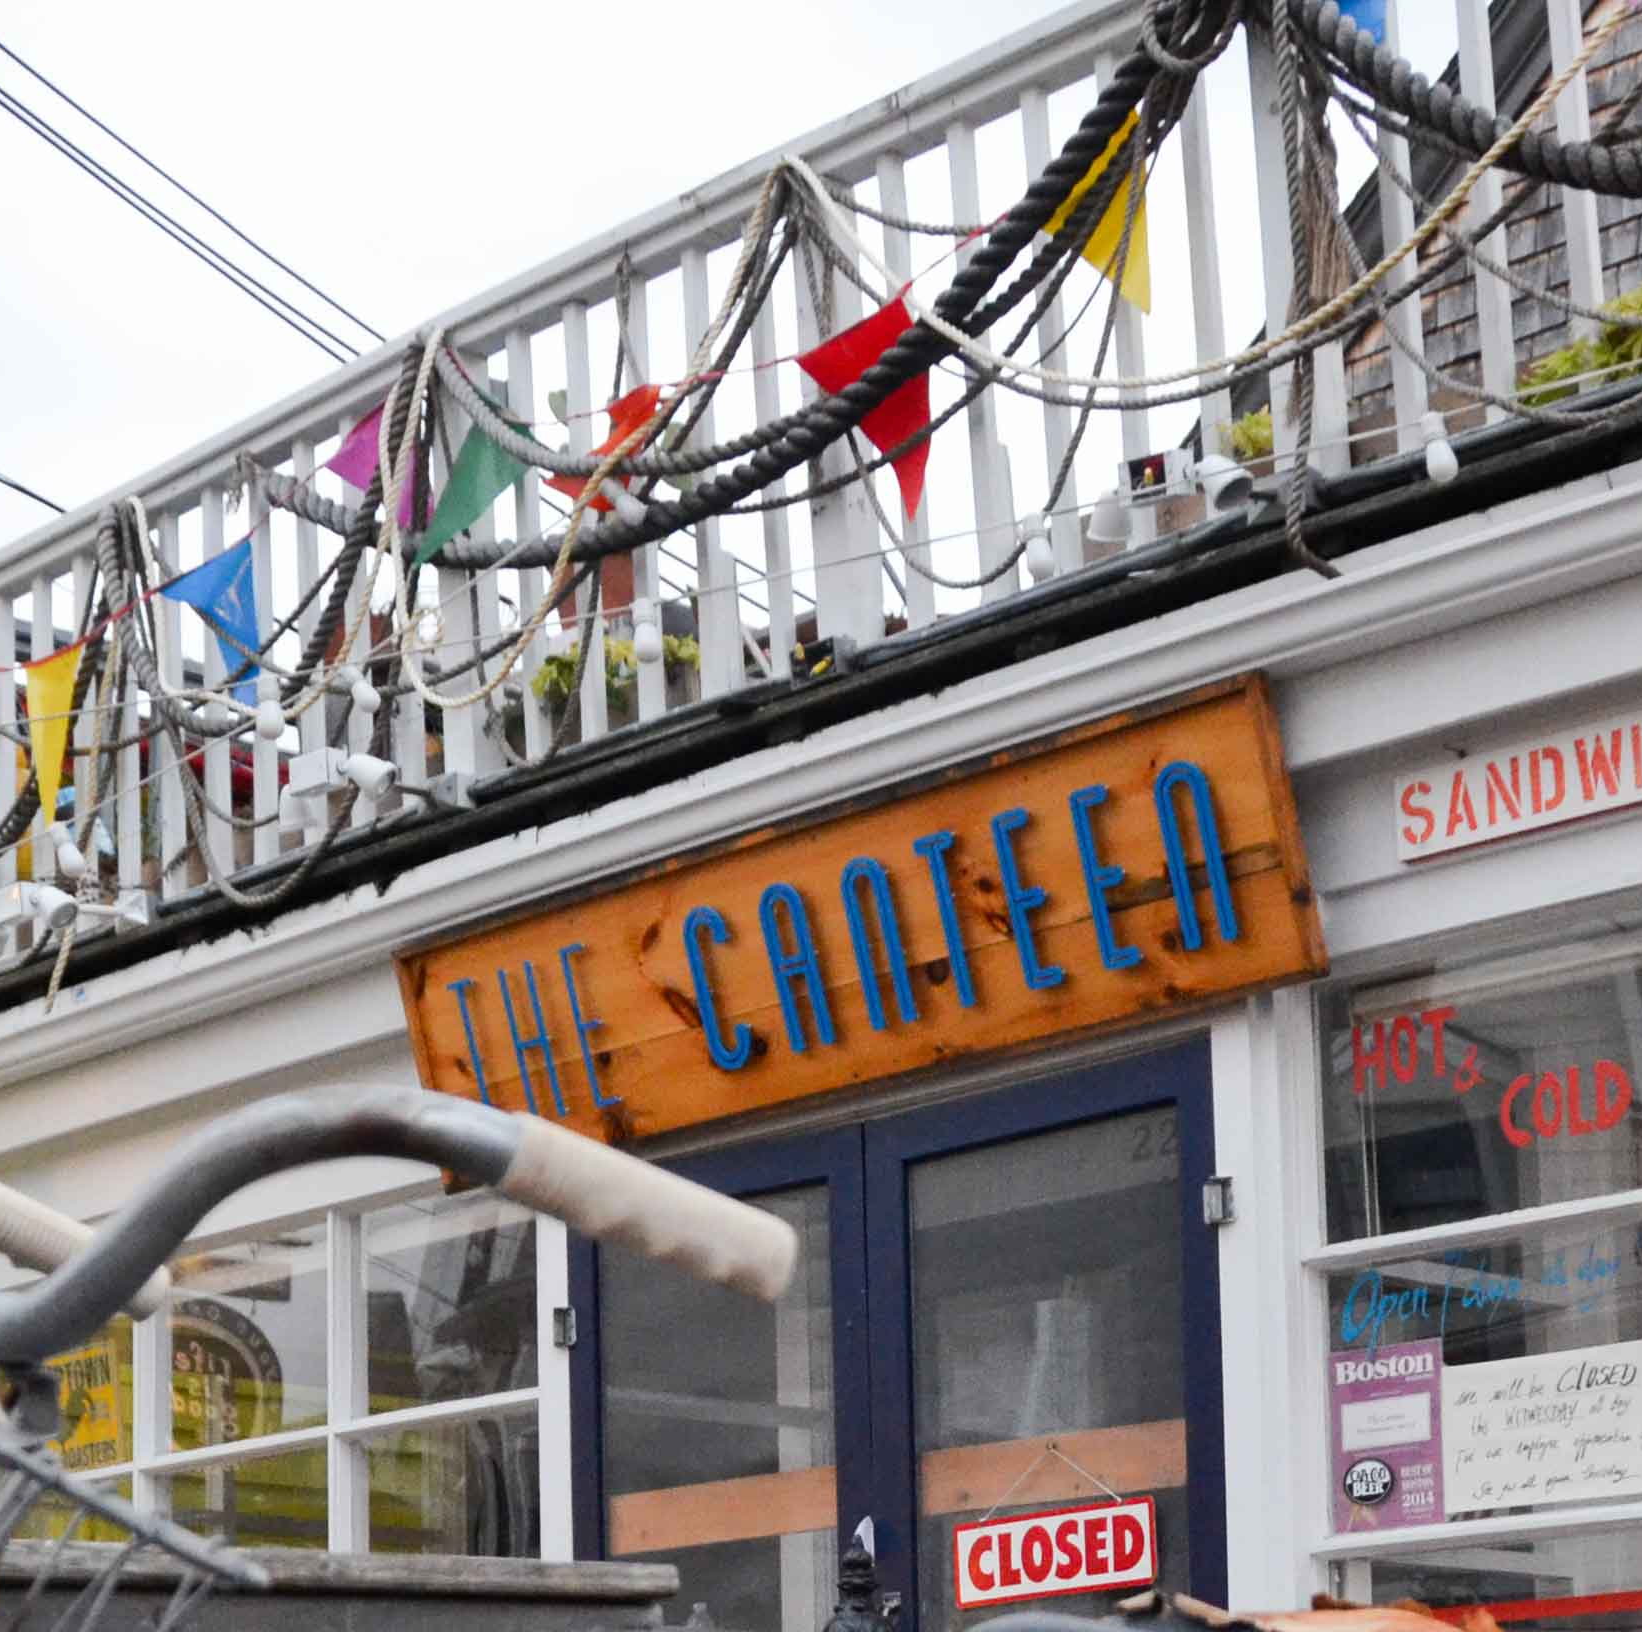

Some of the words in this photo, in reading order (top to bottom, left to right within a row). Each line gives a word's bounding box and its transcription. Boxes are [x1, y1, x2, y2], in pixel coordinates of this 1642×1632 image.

[446, 943, 623, 1117] THE
[682, 760, 1239, 1071] CANTEEN
[1351, 1006, 1457, 1094] HOT
[1453, 1044, 1485, 1094] &
[1500, 1058, 1634, 1148] COLD
[1341, 1268, 1431, 1358] Open
[1334, 1352, 1435, 1385] Boston
[1352, 1481, 1385, 1498] BEER
[1401, 1490, 1435, 1507] 2014
[967, 1513, 1145, 1592] CLOSED
